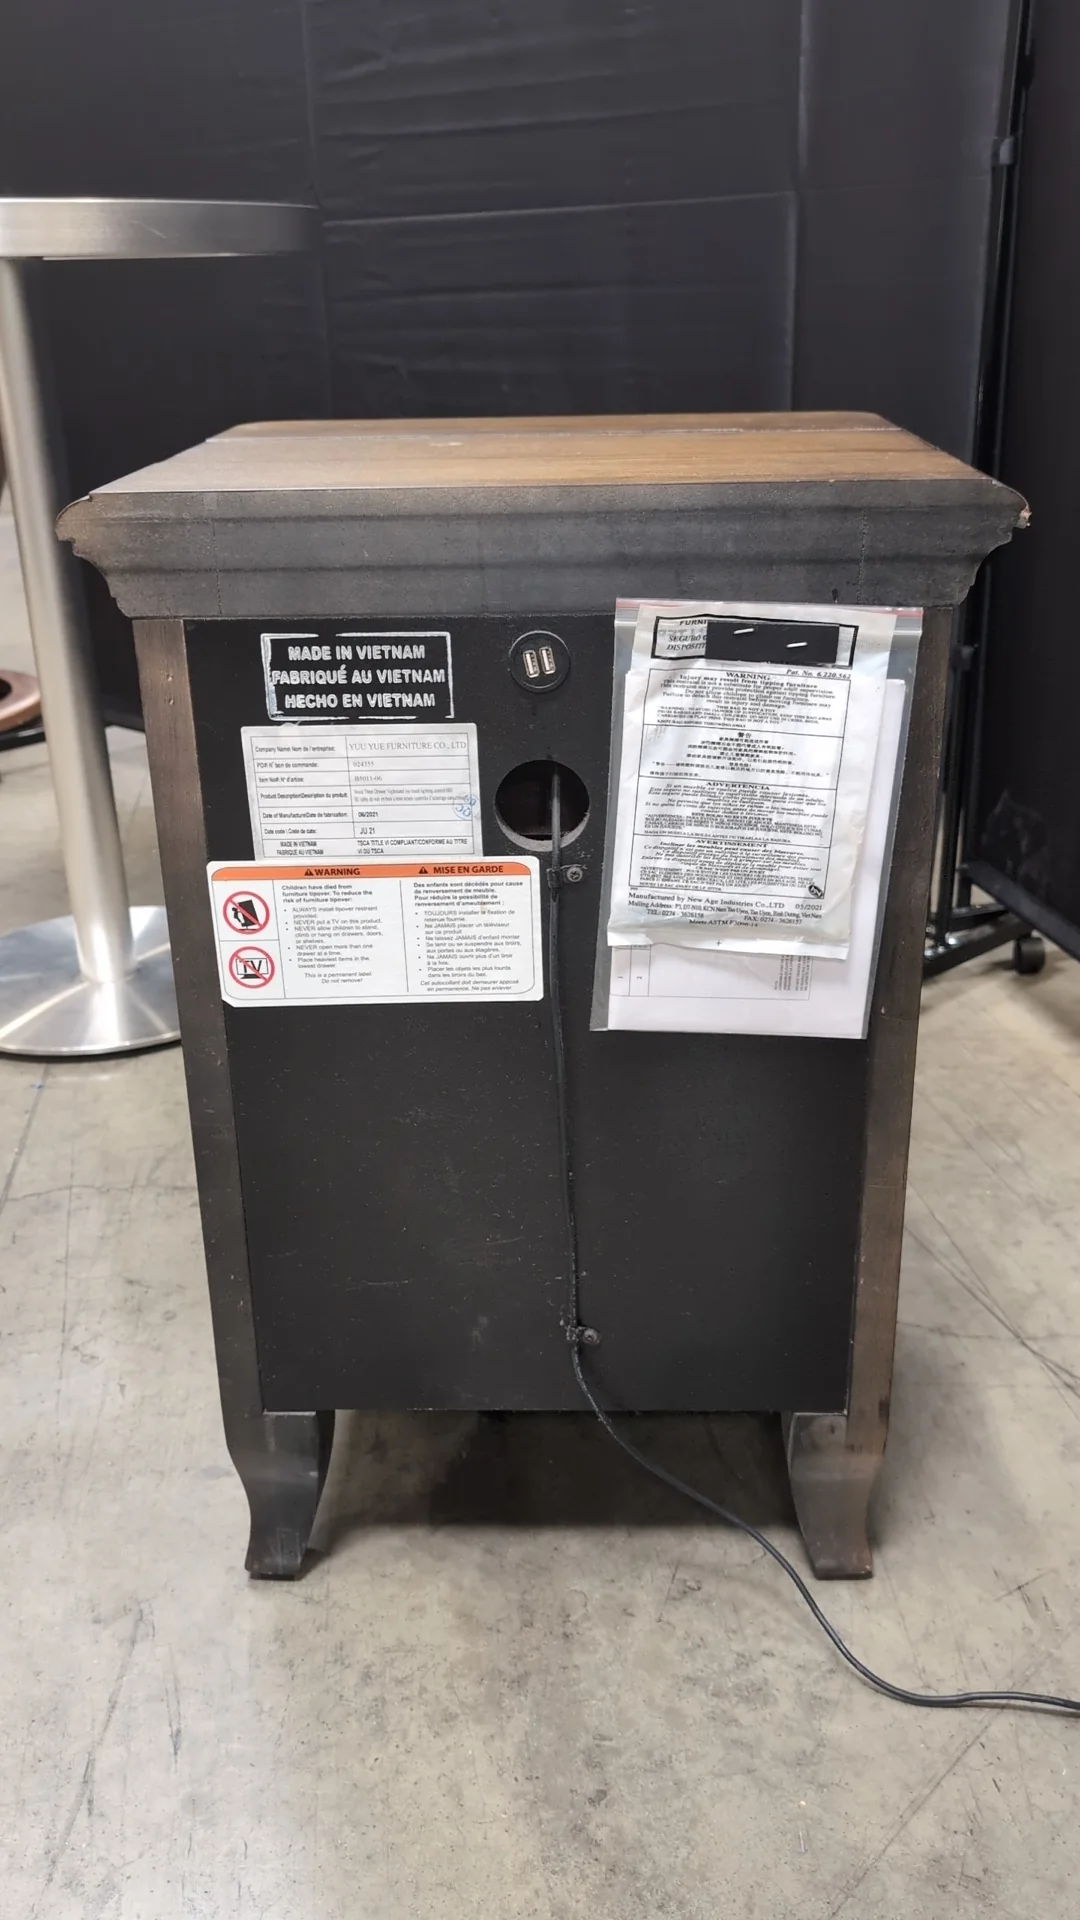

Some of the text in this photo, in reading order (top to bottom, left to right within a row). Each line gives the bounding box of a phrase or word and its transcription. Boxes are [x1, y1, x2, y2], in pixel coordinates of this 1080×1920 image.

[288, 645, 425, 661] MADE IN VIETNAM
[272, 664, 445, 685] FABRIQUÉ AU VIETNAM
[726, 672, 771, 680] WARNING
[285, 693, 435, 708] HECHO EN VIETNAM
[706, 781, 770, 790] ADVERTENCIA
[695, 839, 768, 848] AVERTISSEMENT
[629, 892, 675, 901] Manufactured
[720, 898, 754, 908] Industries
